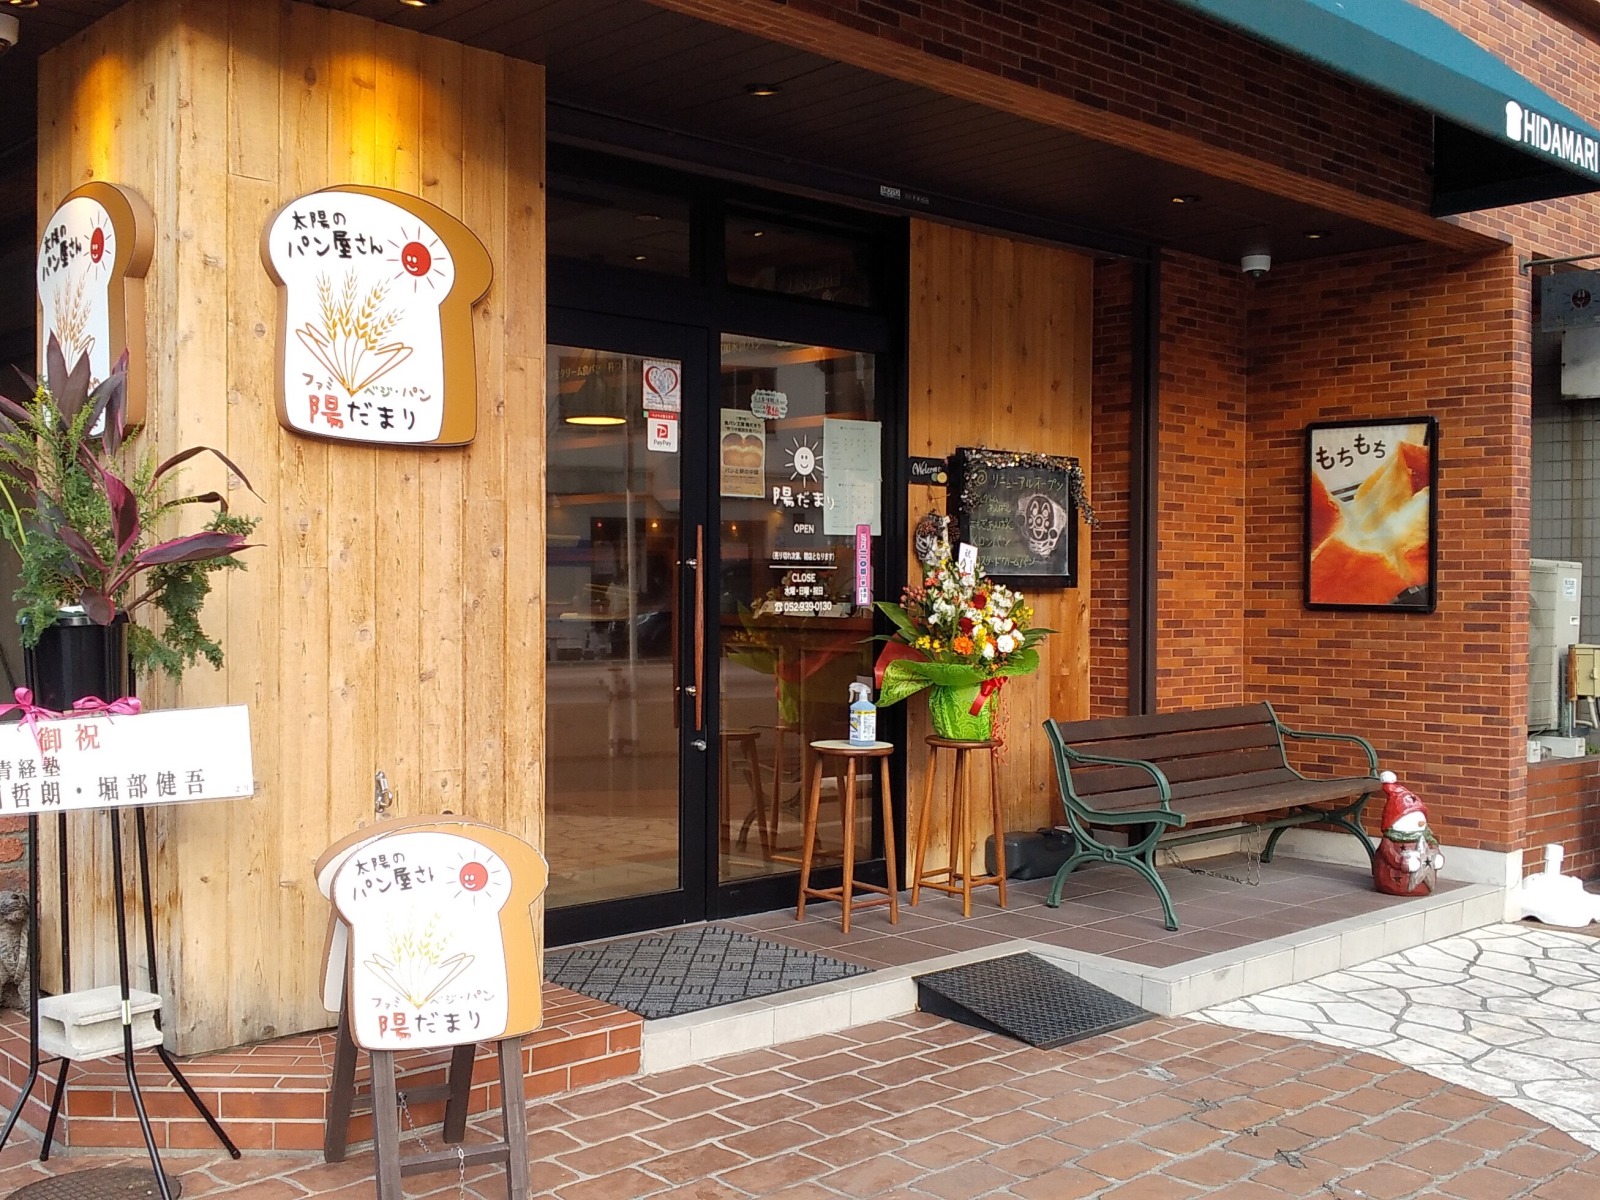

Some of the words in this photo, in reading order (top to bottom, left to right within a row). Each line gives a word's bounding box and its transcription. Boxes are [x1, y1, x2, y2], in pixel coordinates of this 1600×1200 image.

[1523, 109, 1598, 173] HIDAMARI
[292, 210, 346, 230] 太陽の
[42, 236, 82, 282] パン屋さん
[288, 230, 383, 259] パン屋さん
[308, 394, 415, 430] 陽だまり
[653, 439, 671, 447] PayPay
[1316, 433, 1386, 470] もちもち
[773, 486, 835, 510] 陽だまり
[793, 523, 815, 534] OPEN
[791, 573, 816, 583] CLOSE
[783, 602, 832, 612] 052-939-0130
[37, 723, 101, 754] 御祝
[0, 769, 205, 809] 哲朗・堀部健吾
[355, 853, 405, 875] 太陽の
[378, 1011, 480, 1040] 陽だまり
